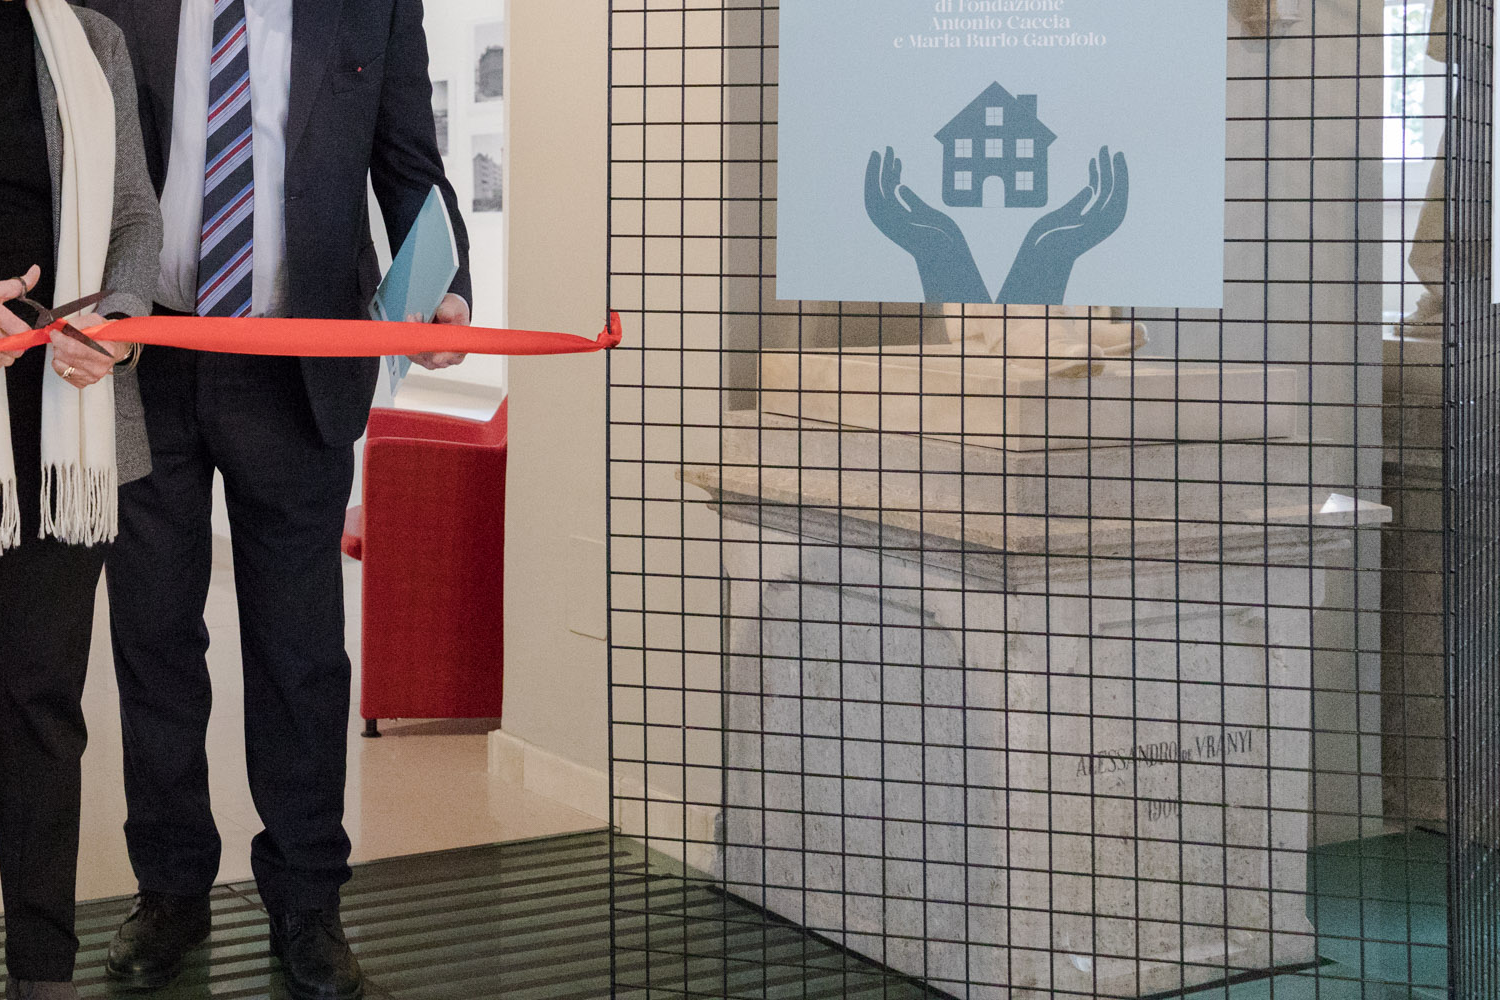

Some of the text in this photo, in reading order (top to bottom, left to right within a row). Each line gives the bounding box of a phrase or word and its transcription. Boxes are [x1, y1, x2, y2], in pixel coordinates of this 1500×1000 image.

[930, 13, 1071, 31] Antonio Caccia
[893, 31, 1108, 49] e Maria Burlo Garofolo
